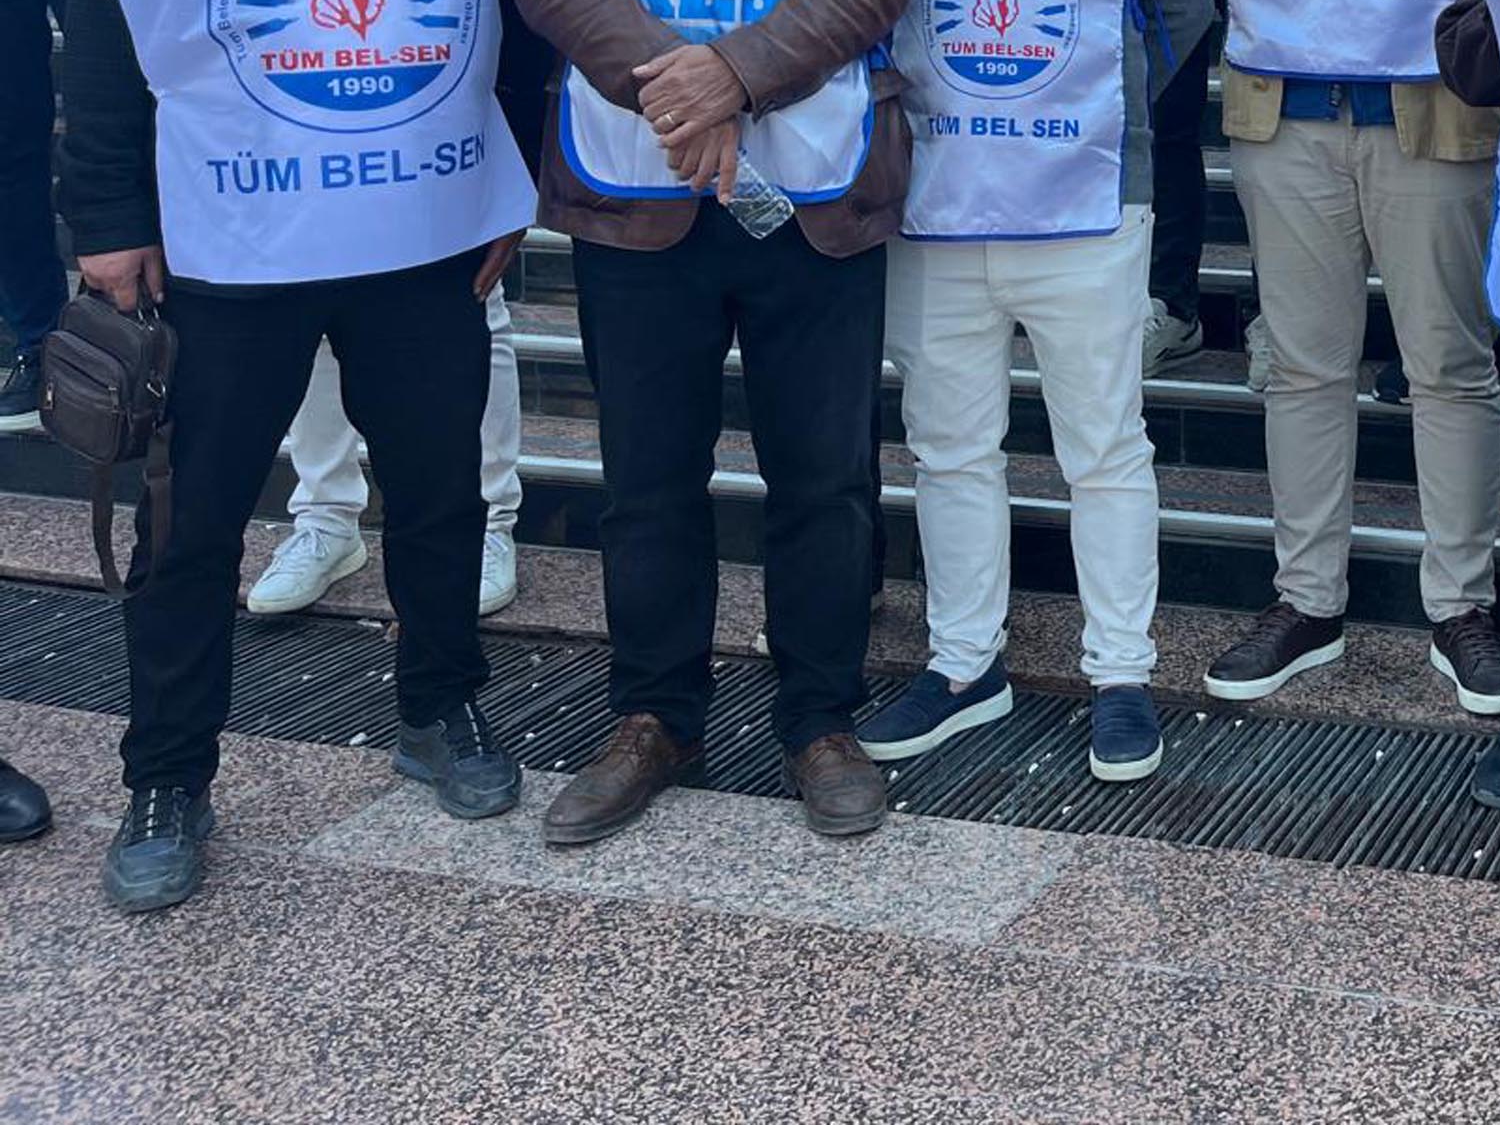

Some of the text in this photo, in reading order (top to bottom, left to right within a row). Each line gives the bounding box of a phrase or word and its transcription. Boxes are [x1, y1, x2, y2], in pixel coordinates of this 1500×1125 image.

[260, 43, 452, 71] TÜM BEL-SEN
[983, 42, 1057, 59] BEL-SEN
[974, 62, 1018, 76] 1990
[326, 76, 396, 97] 1990
[970, 116, 1024, 137] BEL
[1032, 118, 1080, 138] SEN
[207, 131, 486, 194] TÜM BEL-SEN
